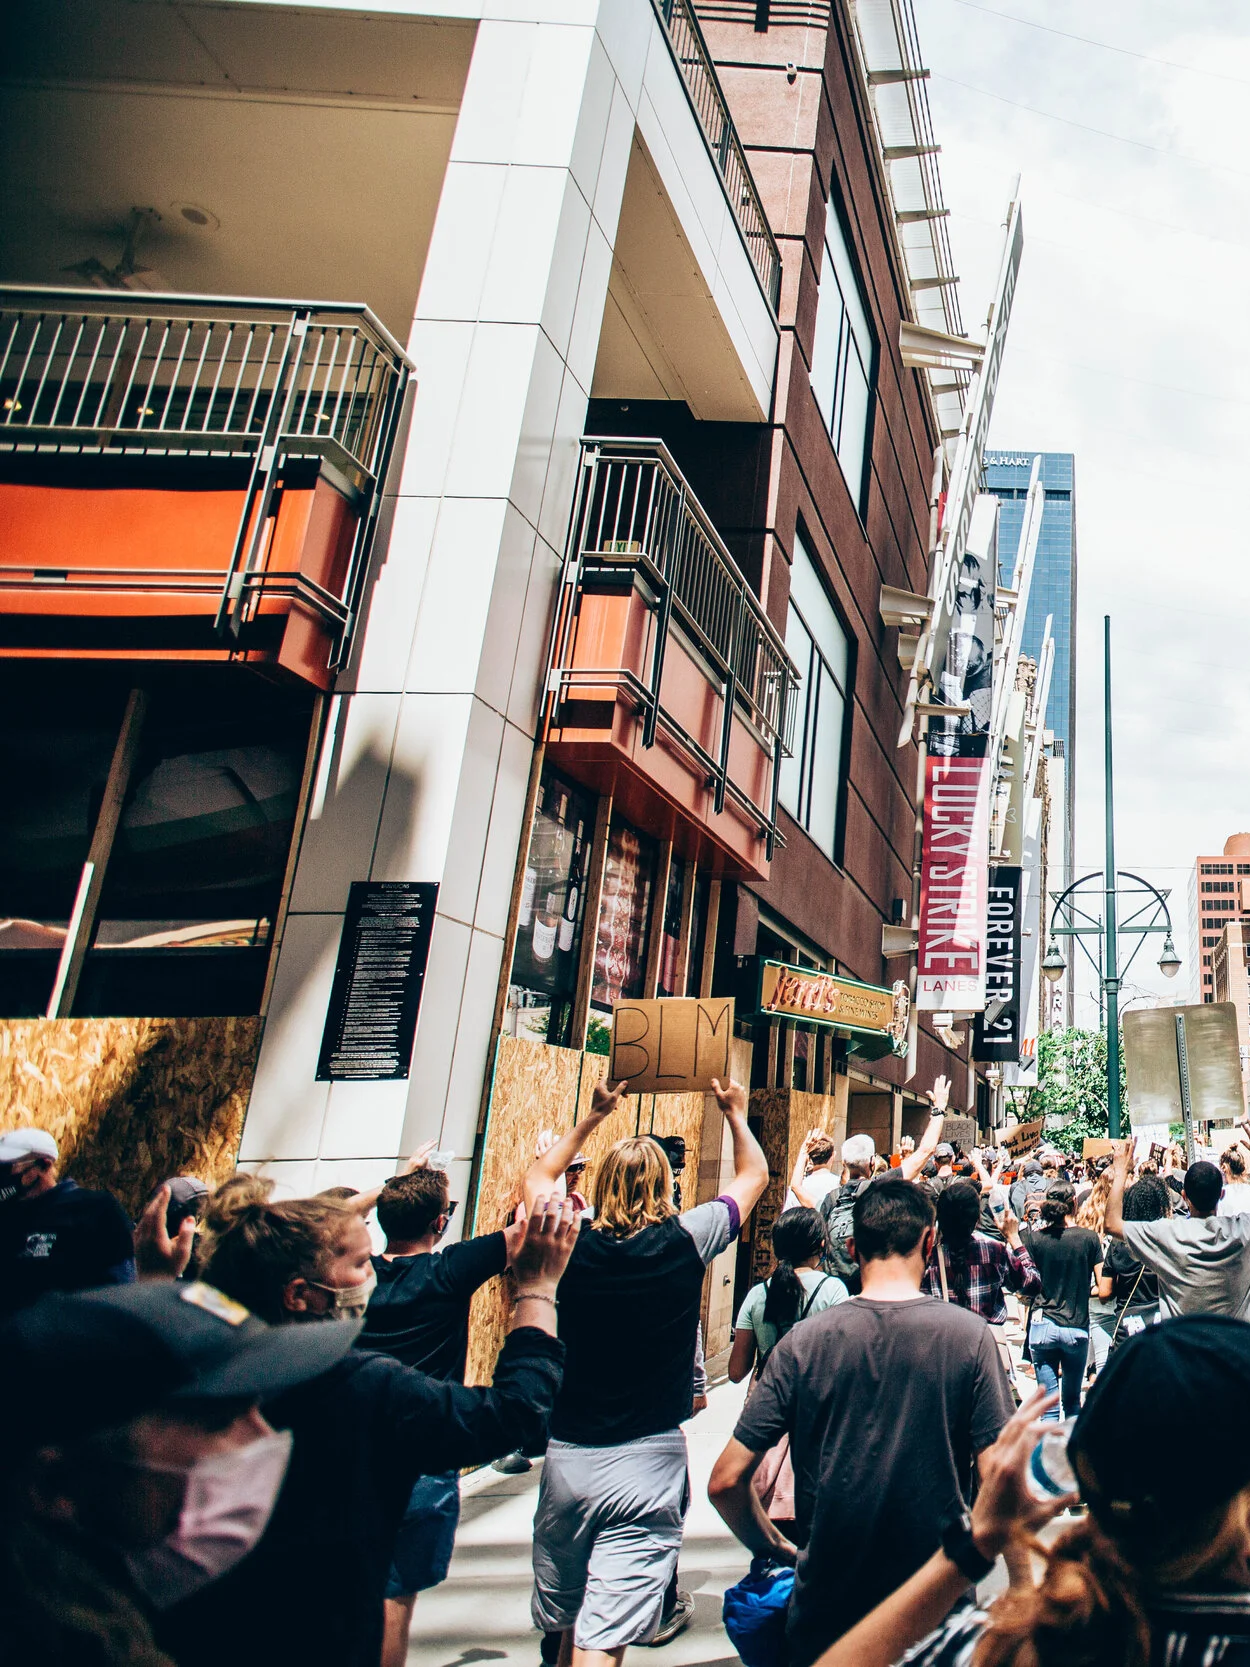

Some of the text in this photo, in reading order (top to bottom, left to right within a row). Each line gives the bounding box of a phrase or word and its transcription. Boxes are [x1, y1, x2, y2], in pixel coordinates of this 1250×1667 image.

[946, 267, 1017, 618] EXPRESS
[989, 456, 999, 465] &
[924, 765, 982, 969] LUCKY STRIKE
[983, 886, 1013, 1044] FOREVER 21
[923, 980, 977, 993] LANES
[839, 992, 886, 1011] TOBACCO SHOP
[845, 1007, 859, 1017] FINE
[860, 1010, 879, 1021] WINES
[610, 1003, 731, 1081] BLM
[945, 1122, 972, 1131] BLACK
[944, 1130, 971, 1138] LIVES
[1021, 1130, 1039, 1142] Lives
